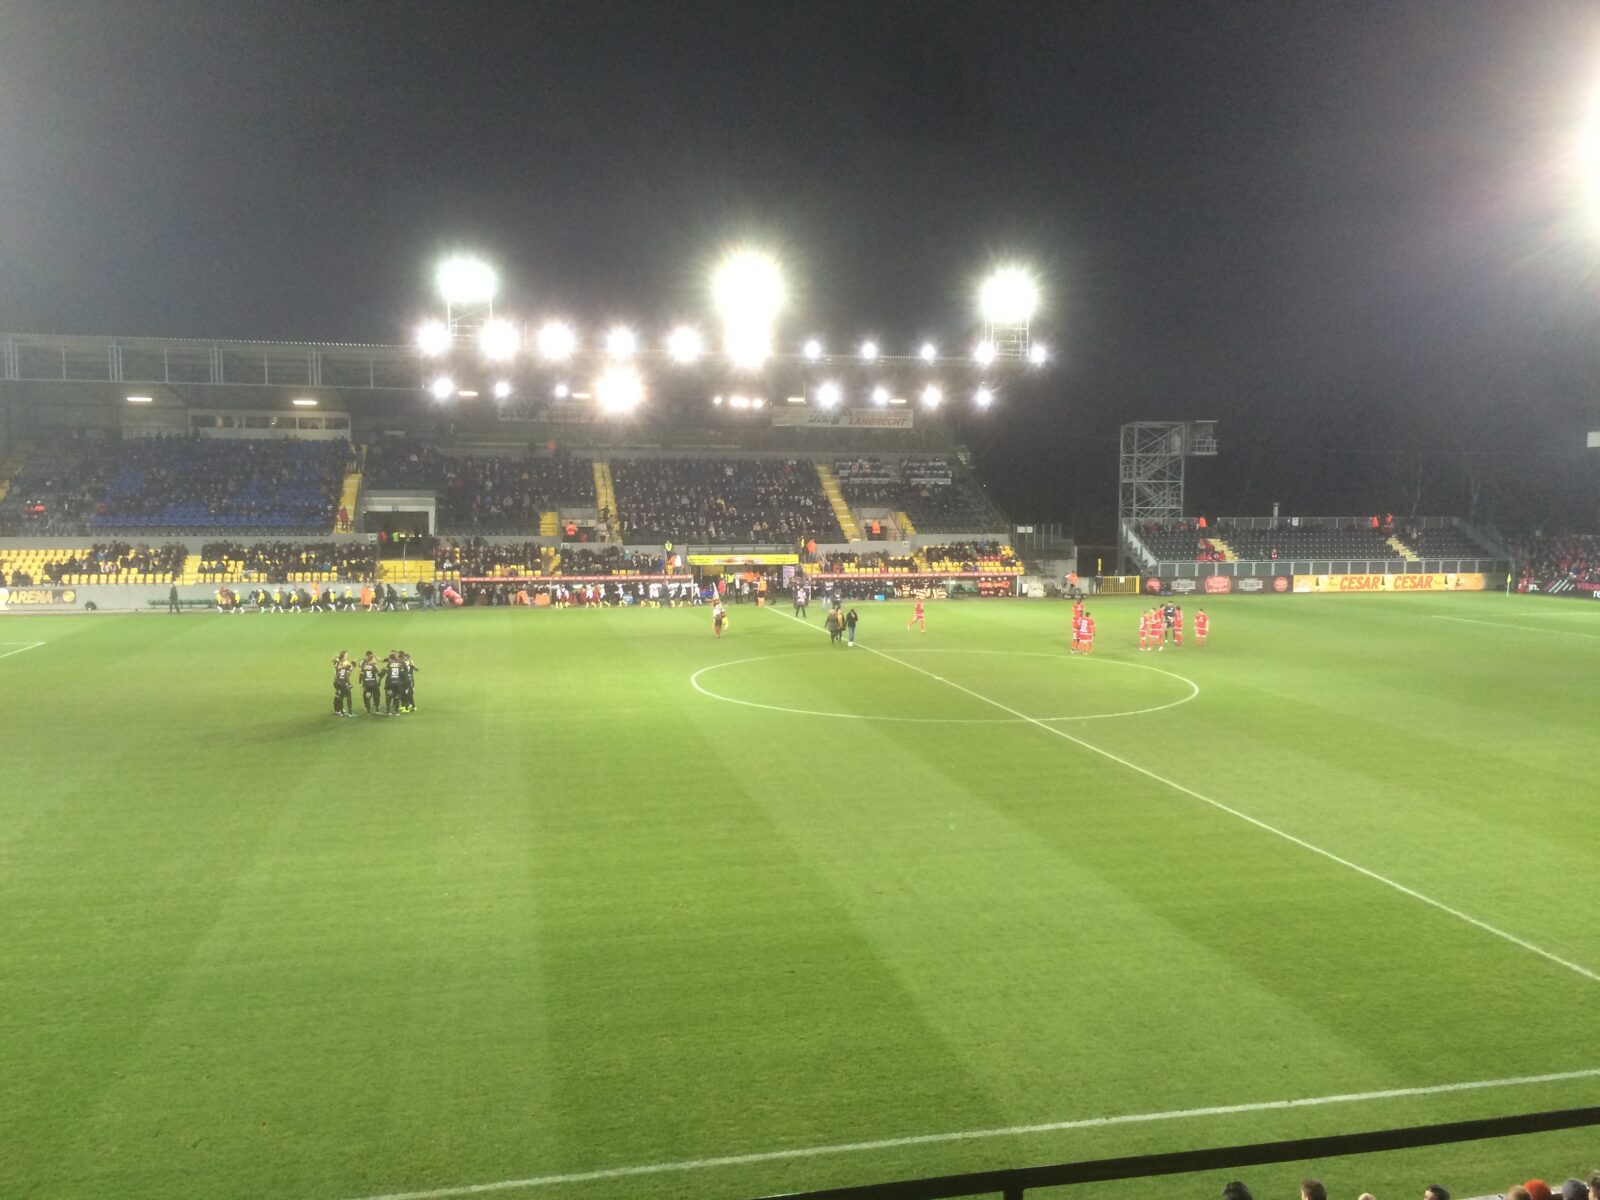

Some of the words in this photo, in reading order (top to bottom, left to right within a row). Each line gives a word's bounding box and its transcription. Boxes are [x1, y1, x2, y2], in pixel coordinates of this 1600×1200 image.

[849, 417, 907, 426] LAMBRECHT
[1340, 576, 1380, 590] CESAR
[1393, 575, 1433, 589] CESAR
[8, 590, 53, 604] ARENA
